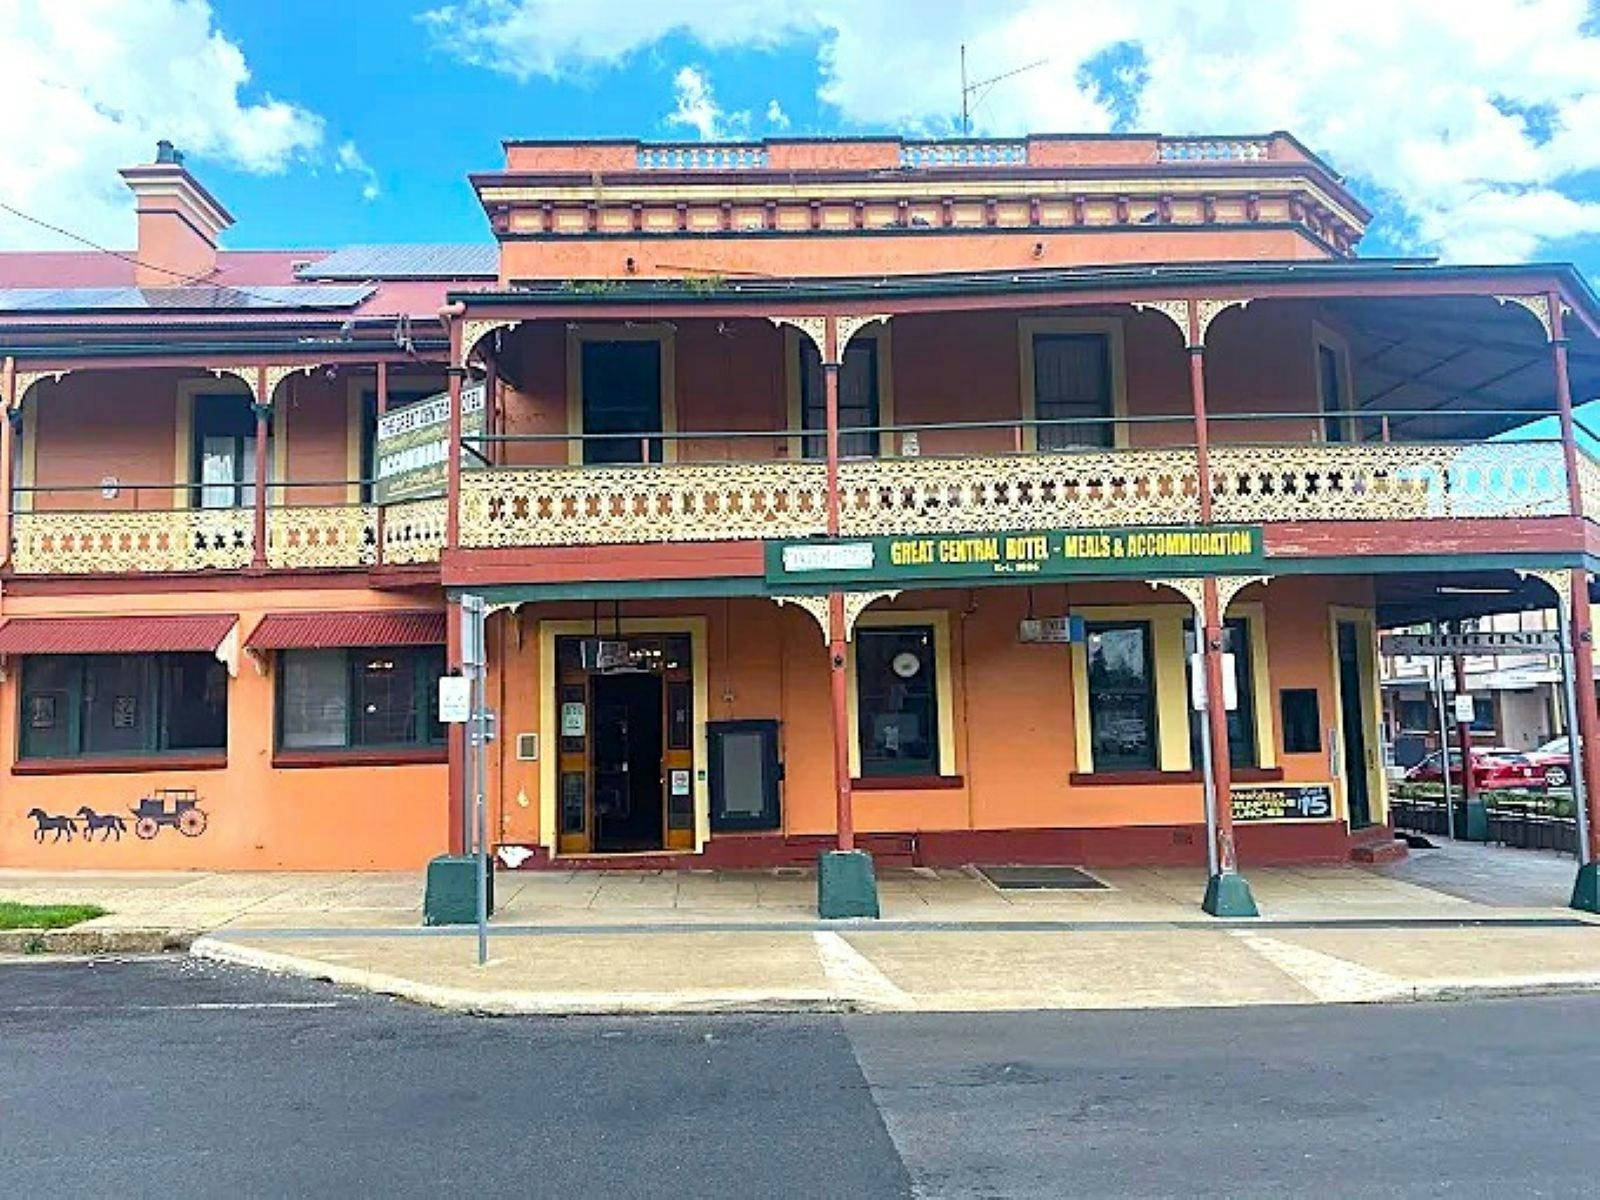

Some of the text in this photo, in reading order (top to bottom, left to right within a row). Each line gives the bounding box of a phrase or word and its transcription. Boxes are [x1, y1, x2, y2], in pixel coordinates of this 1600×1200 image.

[890, 541, 934, 565] GREAT
[940, 538, 999, 563] CENTRAL
[1005, 536, 1049, 560] HOTEL
[1065, 535, 1110, 558] MEALS
[1114, 537, 1124, 557] &
[1127, 531, 1251, 557] ACCOMMODATION
